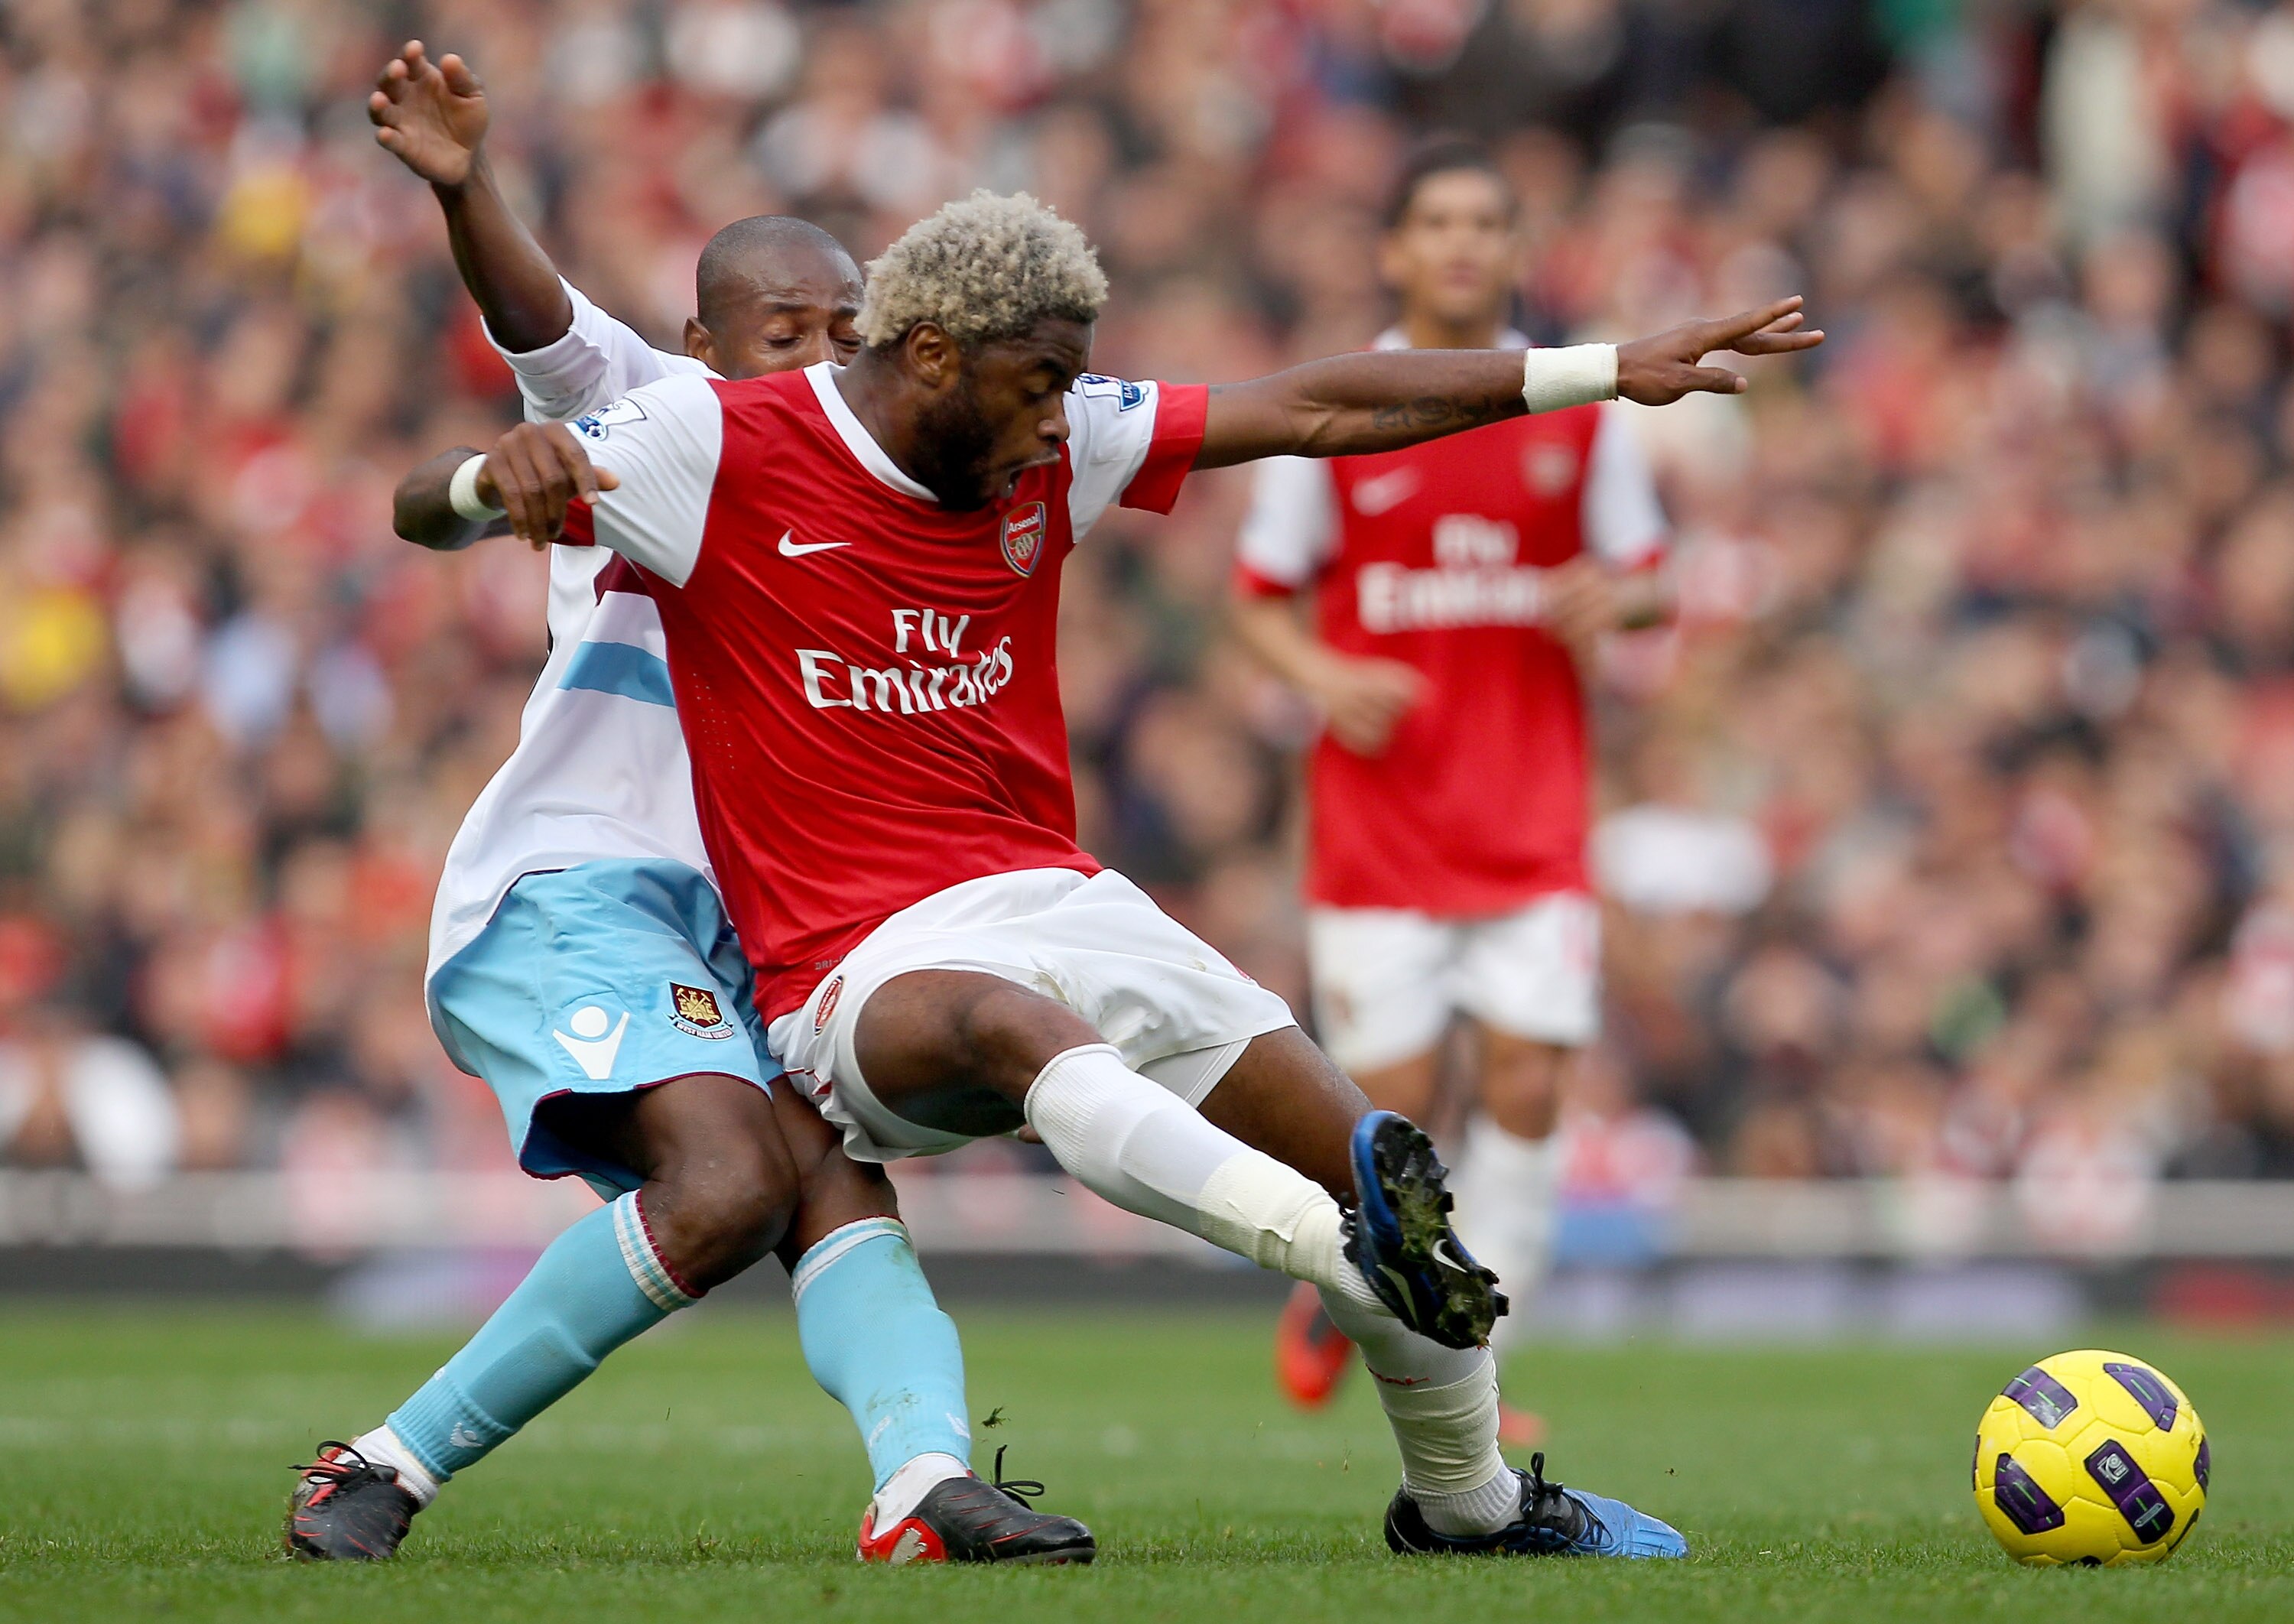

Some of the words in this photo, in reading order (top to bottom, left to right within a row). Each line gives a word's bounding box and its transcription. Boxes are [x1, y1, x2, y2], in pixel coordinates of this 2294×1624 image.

[1007, 512, 1039, 533] Arsenal
[891, 609, 970, 658] Fly
[794, 636, 1013, 714] Emirates
[676, 1021, 696, 1034] WEST
